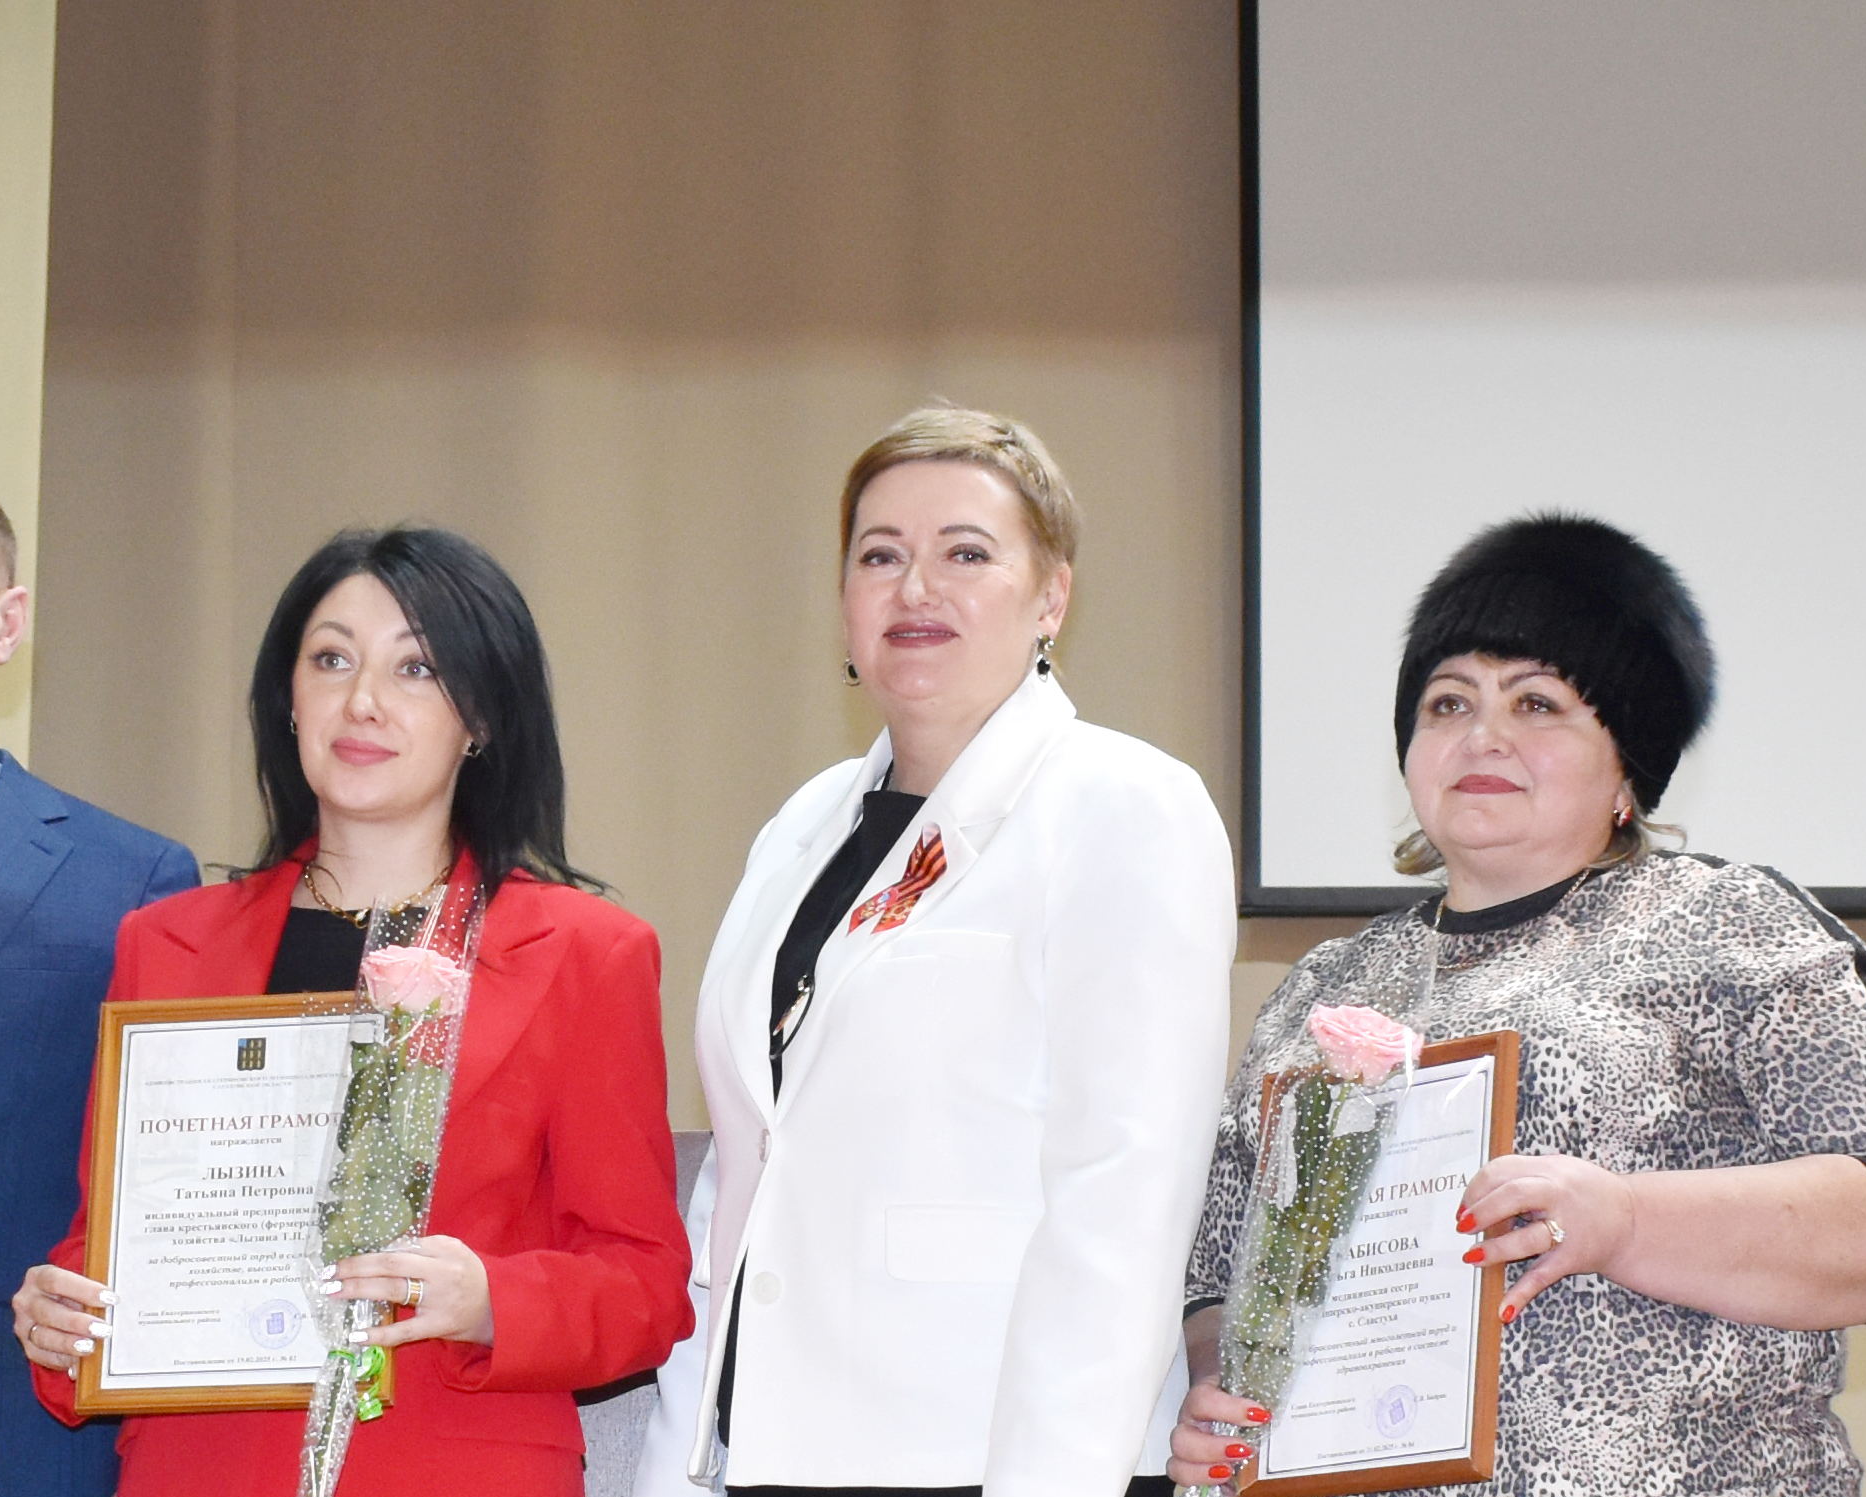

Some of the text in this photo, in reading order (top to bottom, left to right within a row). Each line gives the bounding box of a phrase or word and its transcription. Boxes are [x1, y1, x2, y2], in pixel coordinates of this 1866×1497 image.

[140, 1112, 343, 1134] ПОЧЕТНАЯ ГРАМОТ
[211, 1137, 283, 1149] награждается
[202, 1165, 286, 1181] ЛЫЗИНА
[174, 1185, 314, 1200] Татьяна Петровна
[1390, 1173, 1468, 1200] ГРАМОТА
[1359, 1207, 1408, 1222] раждается
[1336, 1236, 1420, 1261] АБИСОВА
[1337, 1257, 1433, 1281] ьга Николаевна
